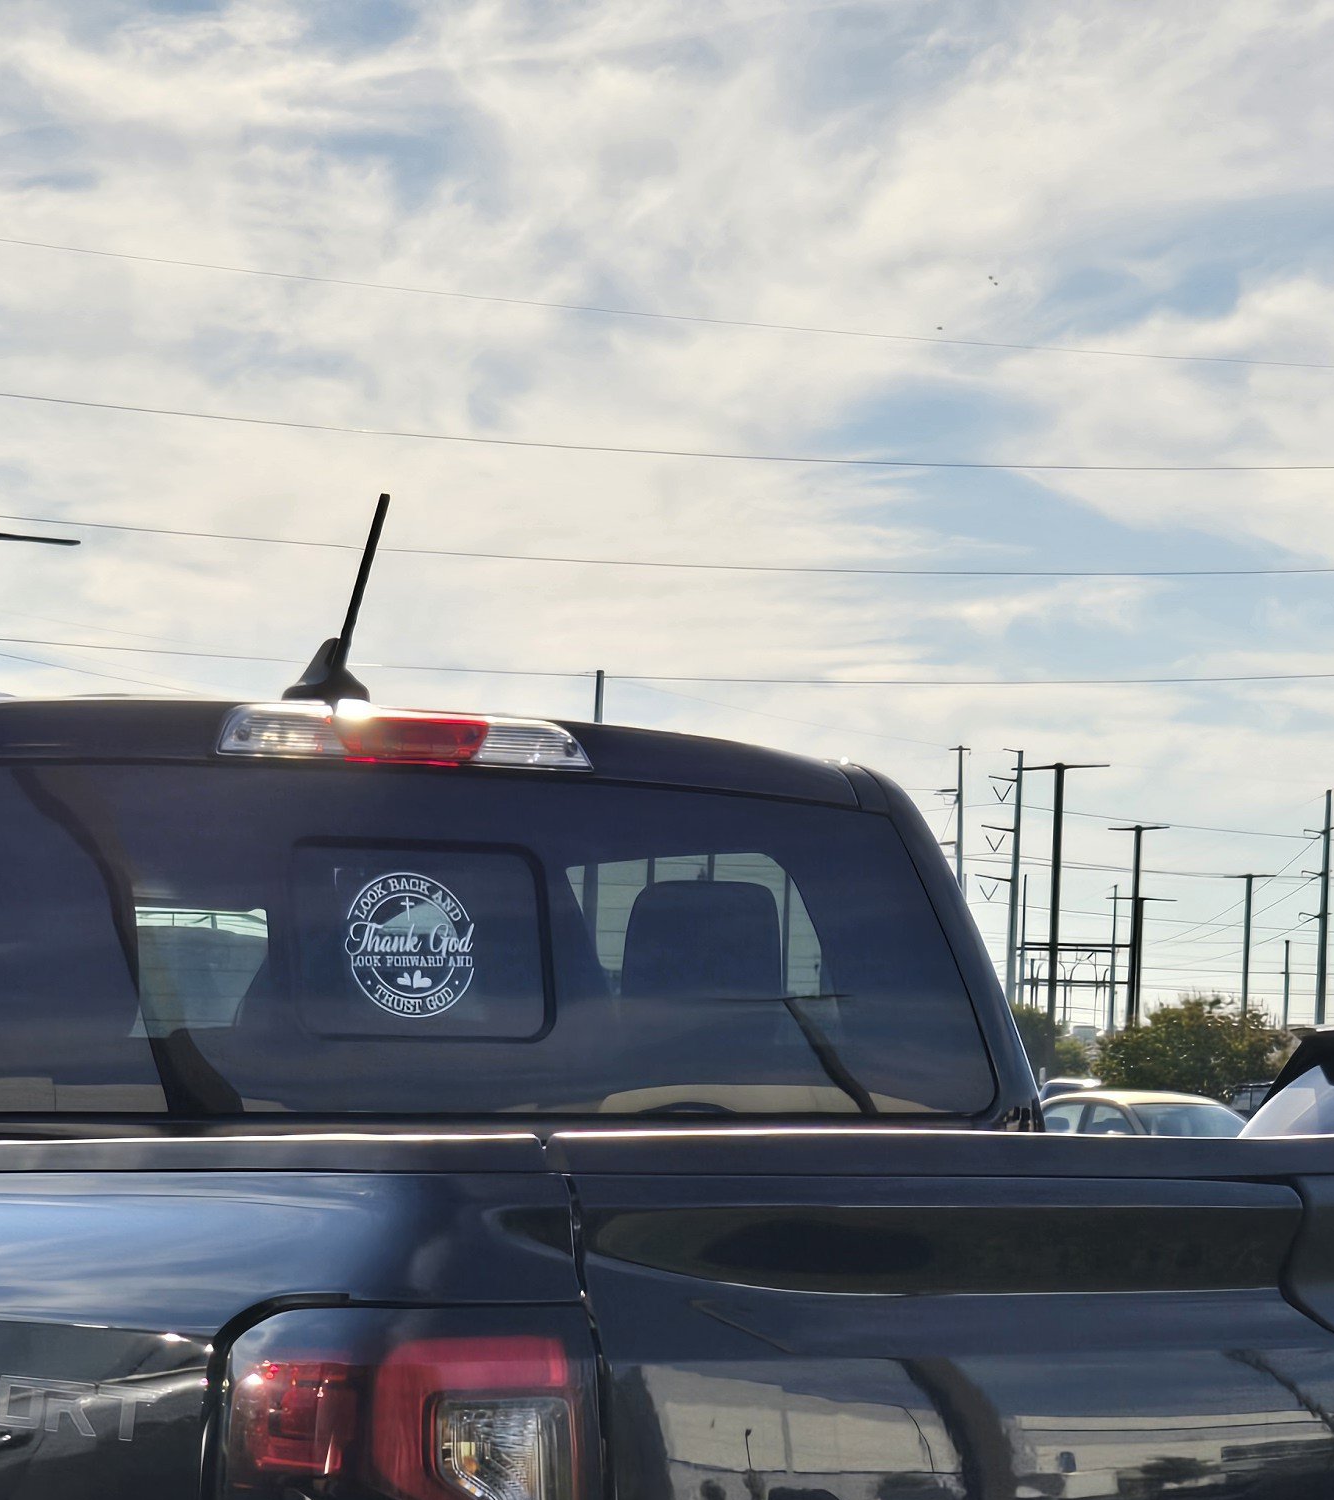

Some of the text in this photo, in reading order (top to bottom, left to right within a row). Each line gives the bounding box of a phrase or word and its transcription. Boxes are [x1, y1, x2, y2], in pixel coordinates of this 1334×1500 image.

[354, 878, 462, 922] LOOK BACK AND
[345, 921, 474, 958] Thank God
[352, 955, 473, 967] LOOK FORWARD AND
[374, 984, 454, 1013] TRUST GOD
